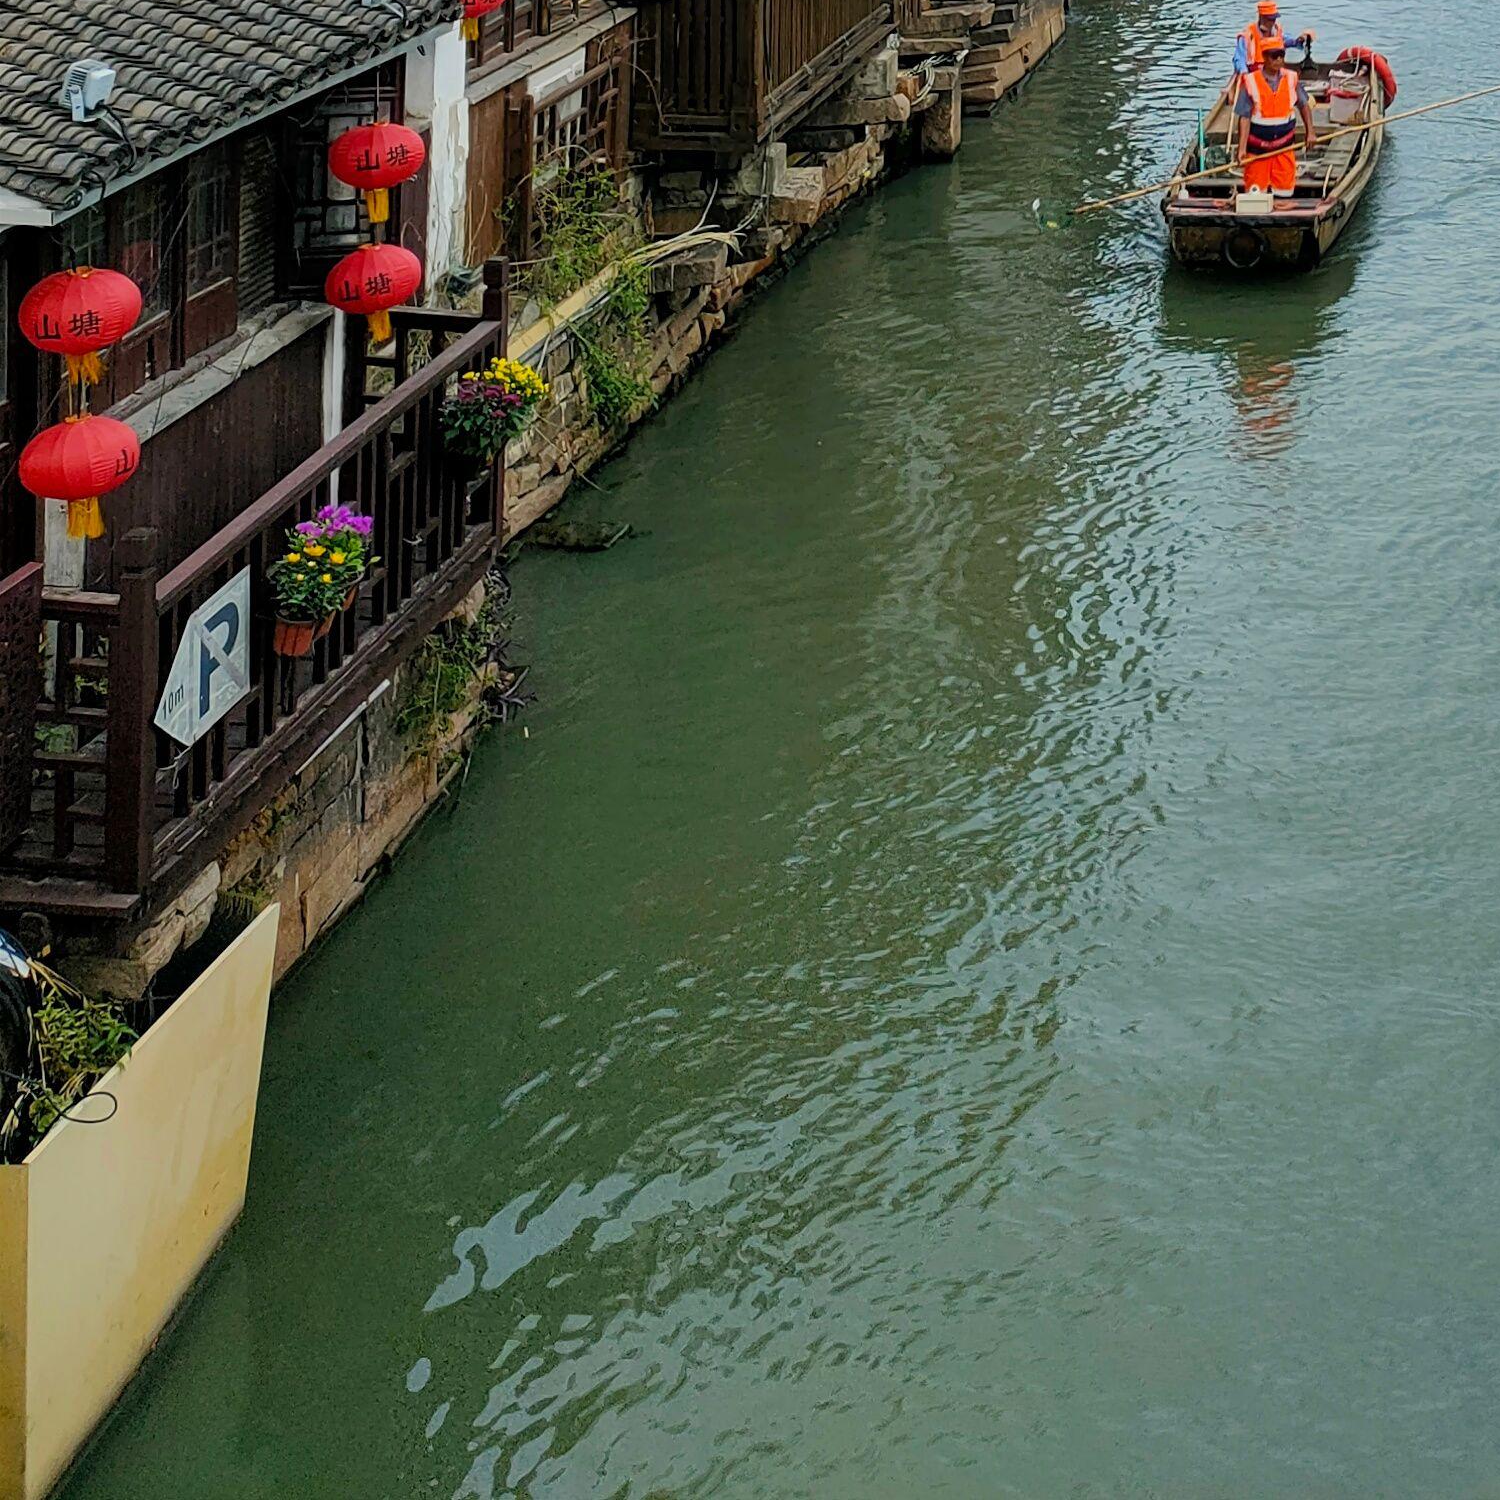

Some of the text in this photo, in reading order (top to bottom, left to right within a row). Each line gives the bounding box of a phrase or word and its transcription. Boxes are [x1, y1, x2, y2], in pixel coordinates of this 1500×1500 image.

[355, 143, 410, 172] 山塘
[337, 272, 392, 302] 山塘
[34, 309, 103, 340] 山塘
[115, 448, 135, 476] 山
[199, 601, 239, 719] P
[162, 683, 184, 720] 10m
